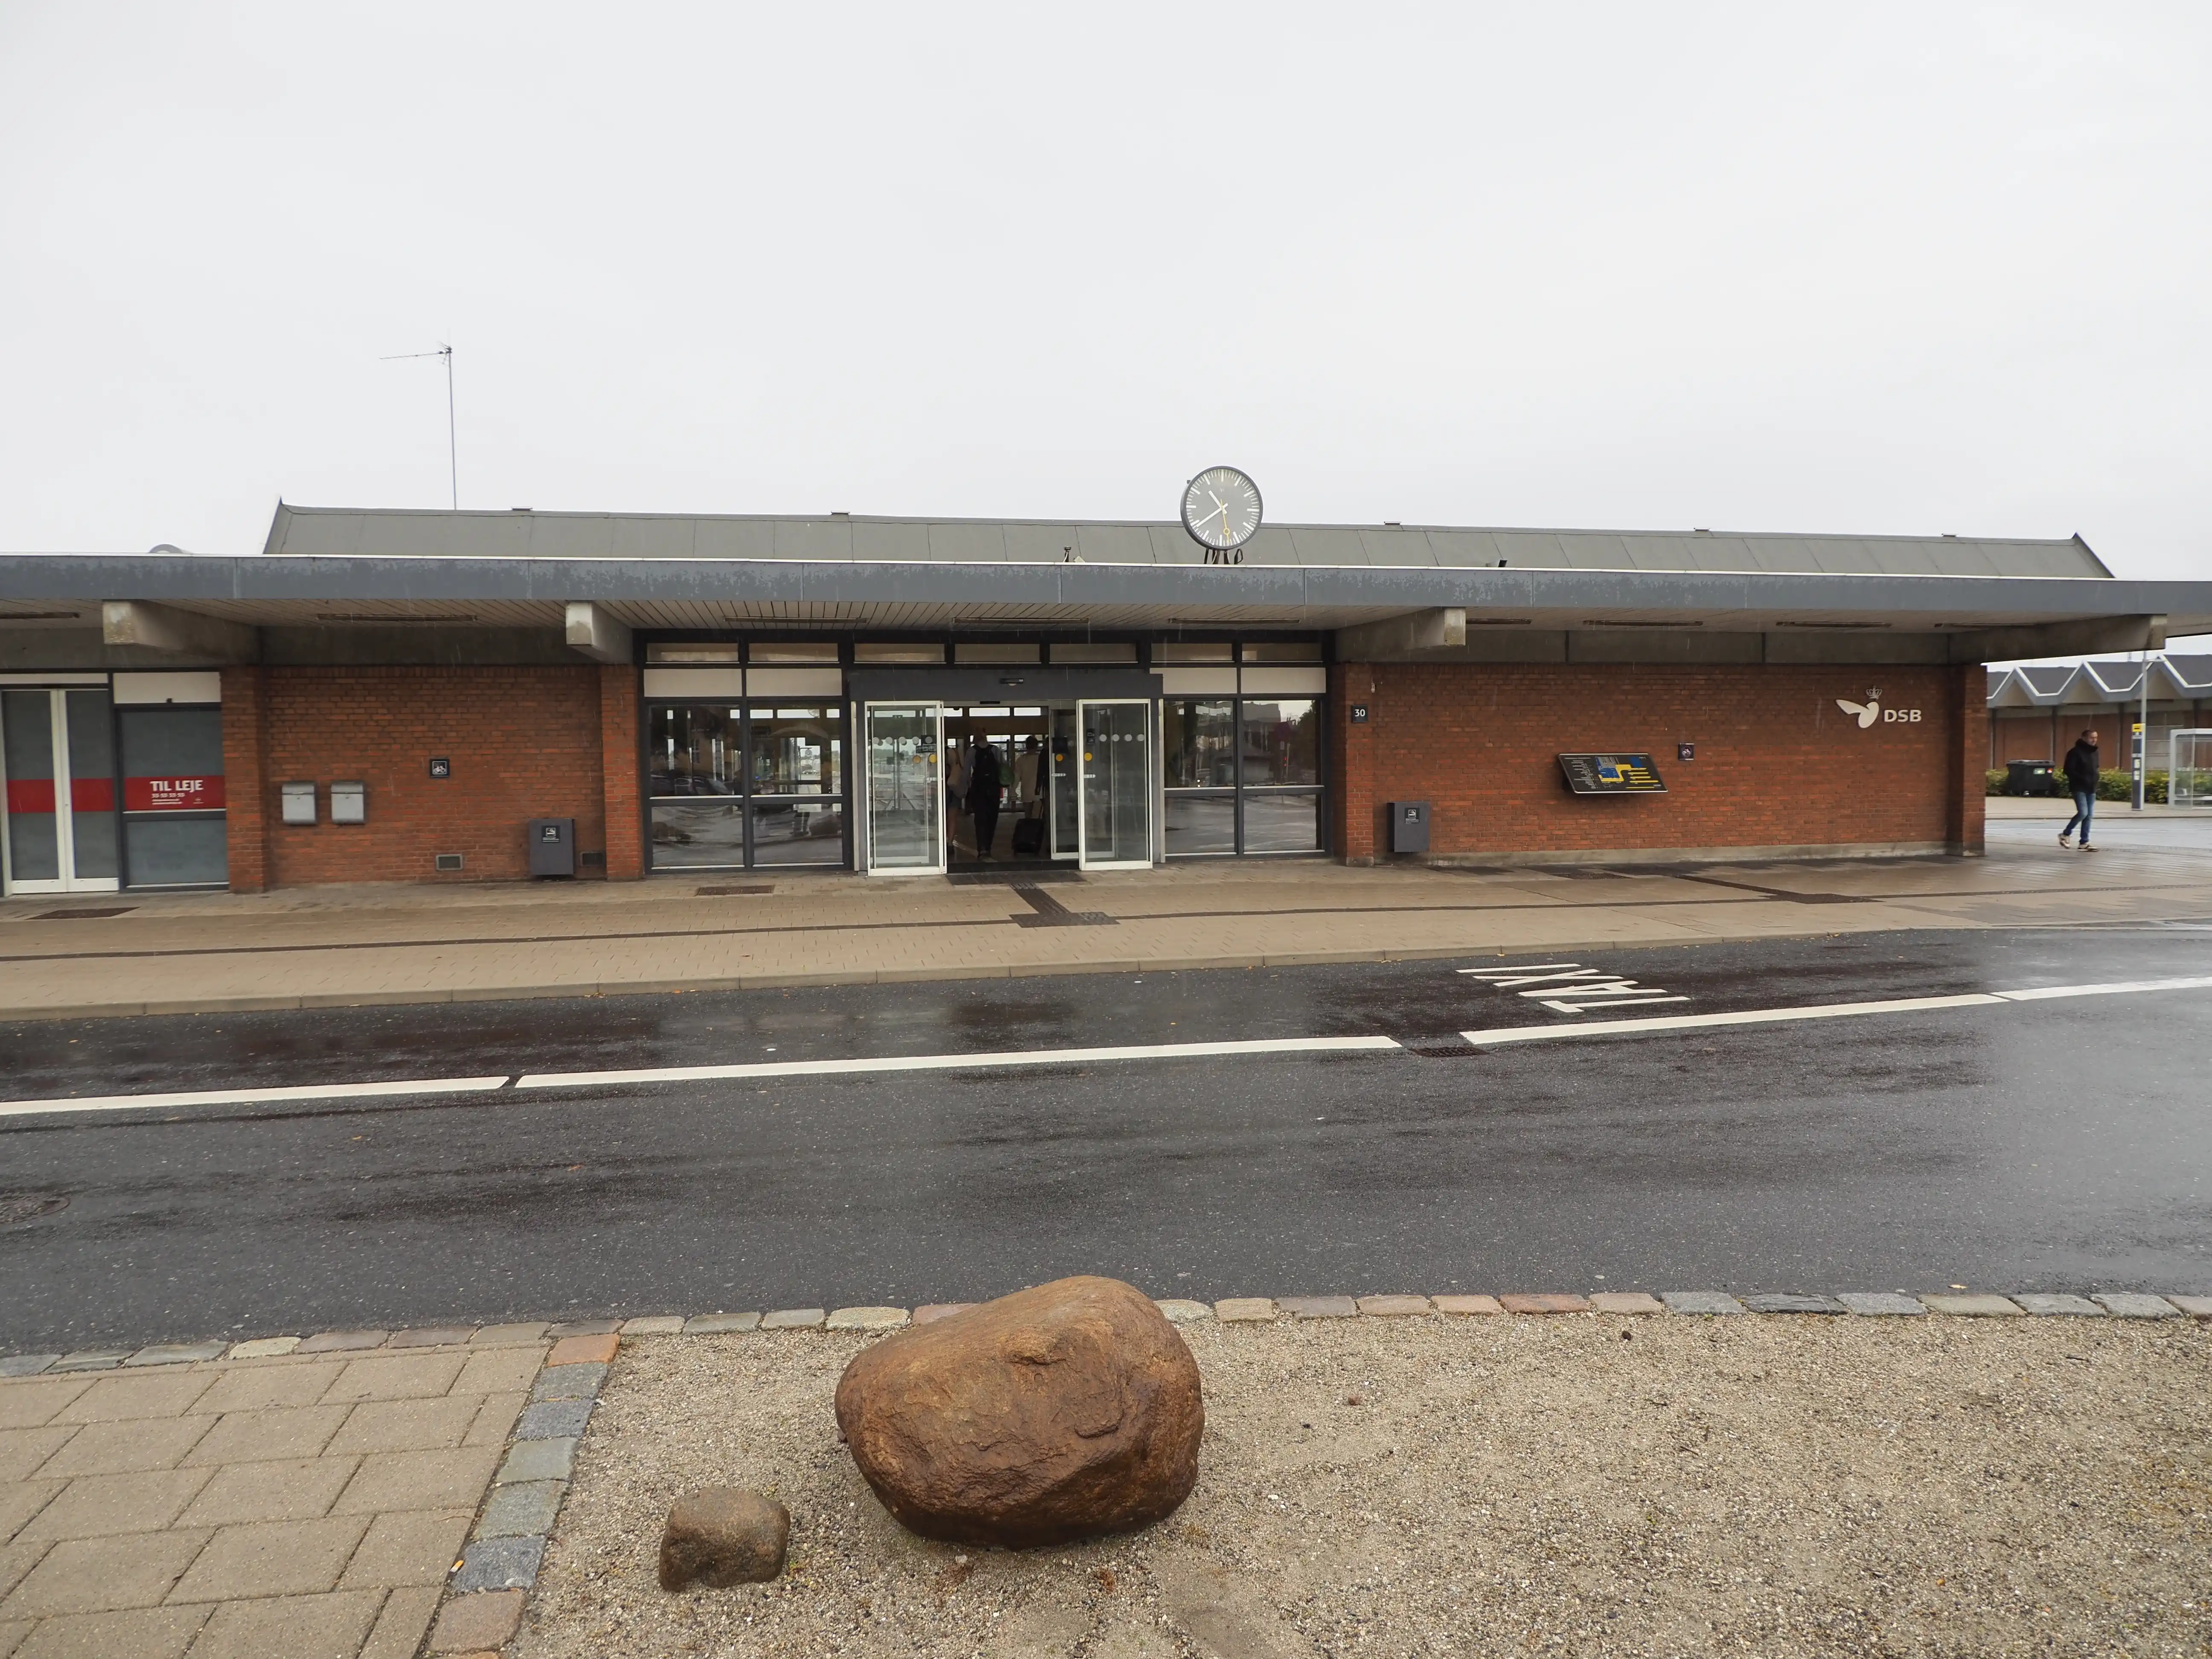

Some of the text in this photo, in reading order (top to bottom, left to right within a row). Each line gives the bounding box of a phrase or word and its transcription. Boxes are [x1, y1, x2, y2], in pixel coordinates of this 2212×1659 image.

[1354, 709, 1365, 717] 30
[1884, 709, 1922, 722] DSB
[149, 780, 204, 793] TIL LEJE
[1455, 963, 1691, 1013] TAXI
